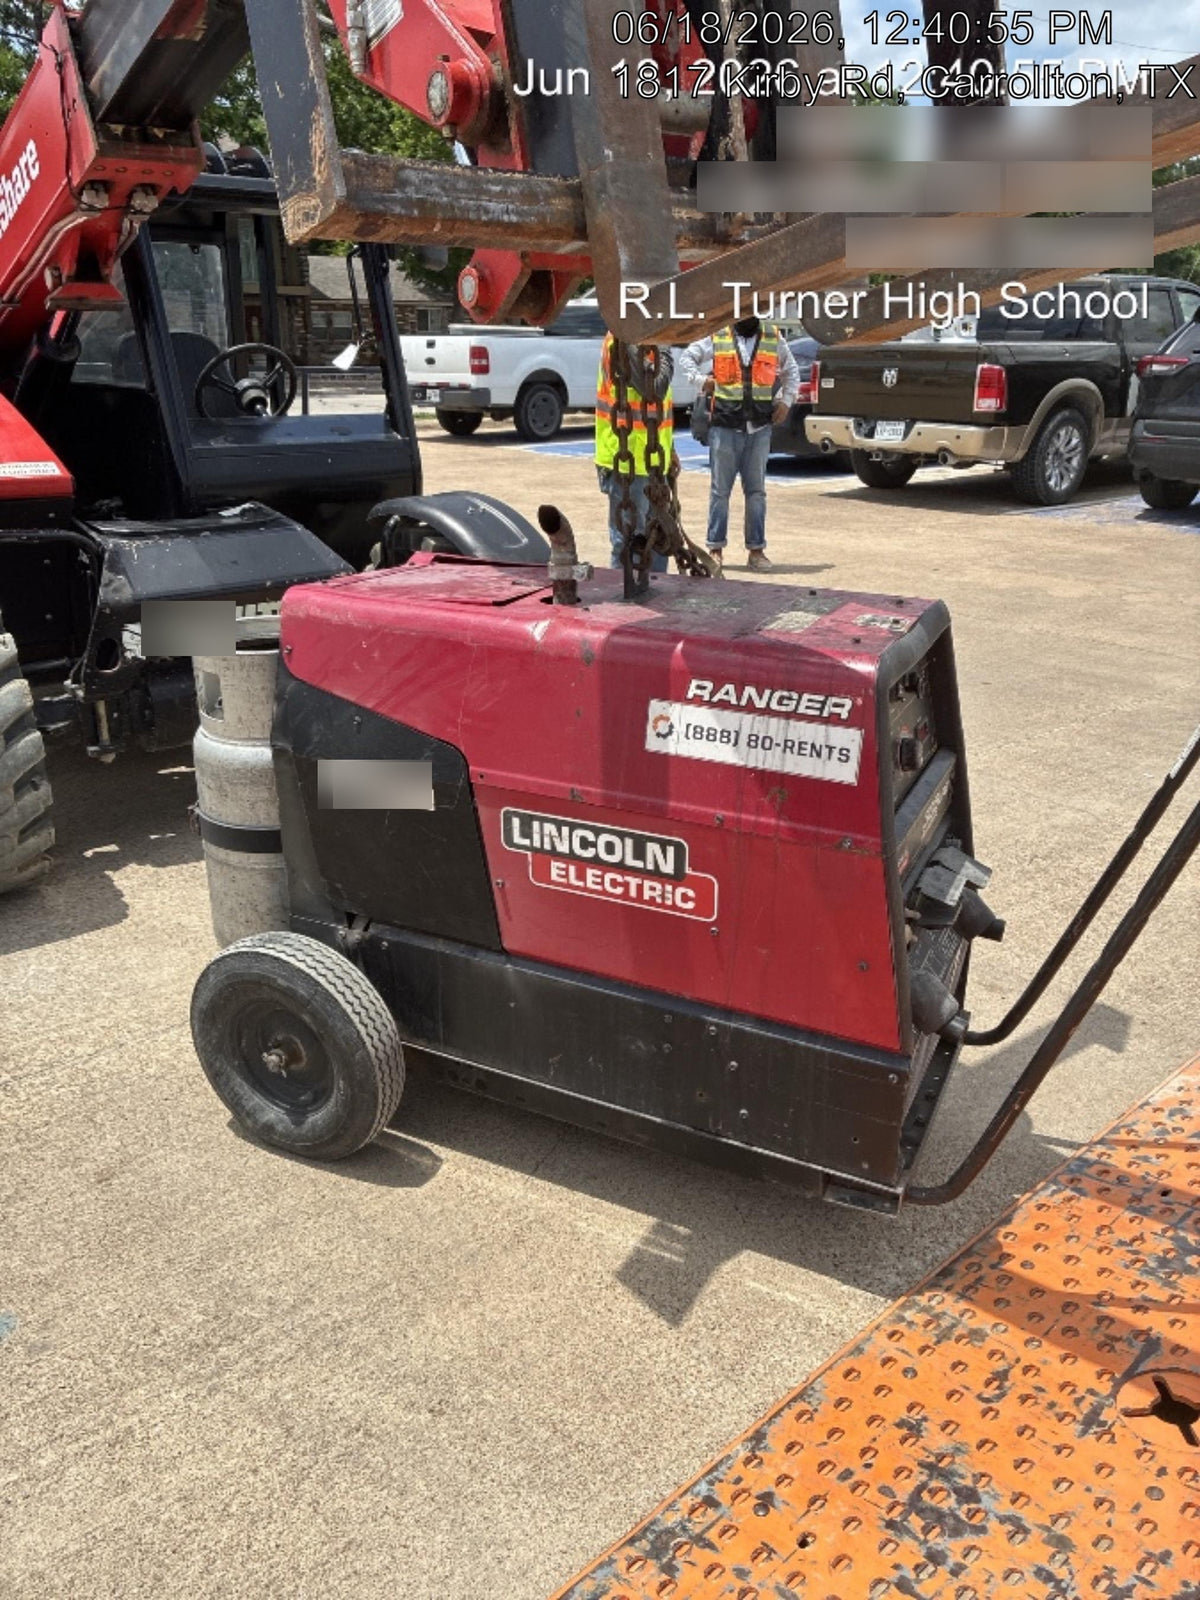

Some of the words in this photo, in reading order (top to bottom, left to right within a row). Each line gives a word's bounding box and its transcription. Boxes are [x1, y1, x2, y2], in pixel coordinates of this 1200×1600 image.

[686, 679, 853, 720] RANGER
[746, 733, 851, 765] 80-RENTS
[511, 816, 676, 876] LINCOLN
[550, 859, 696, 910] ELECTRIC
